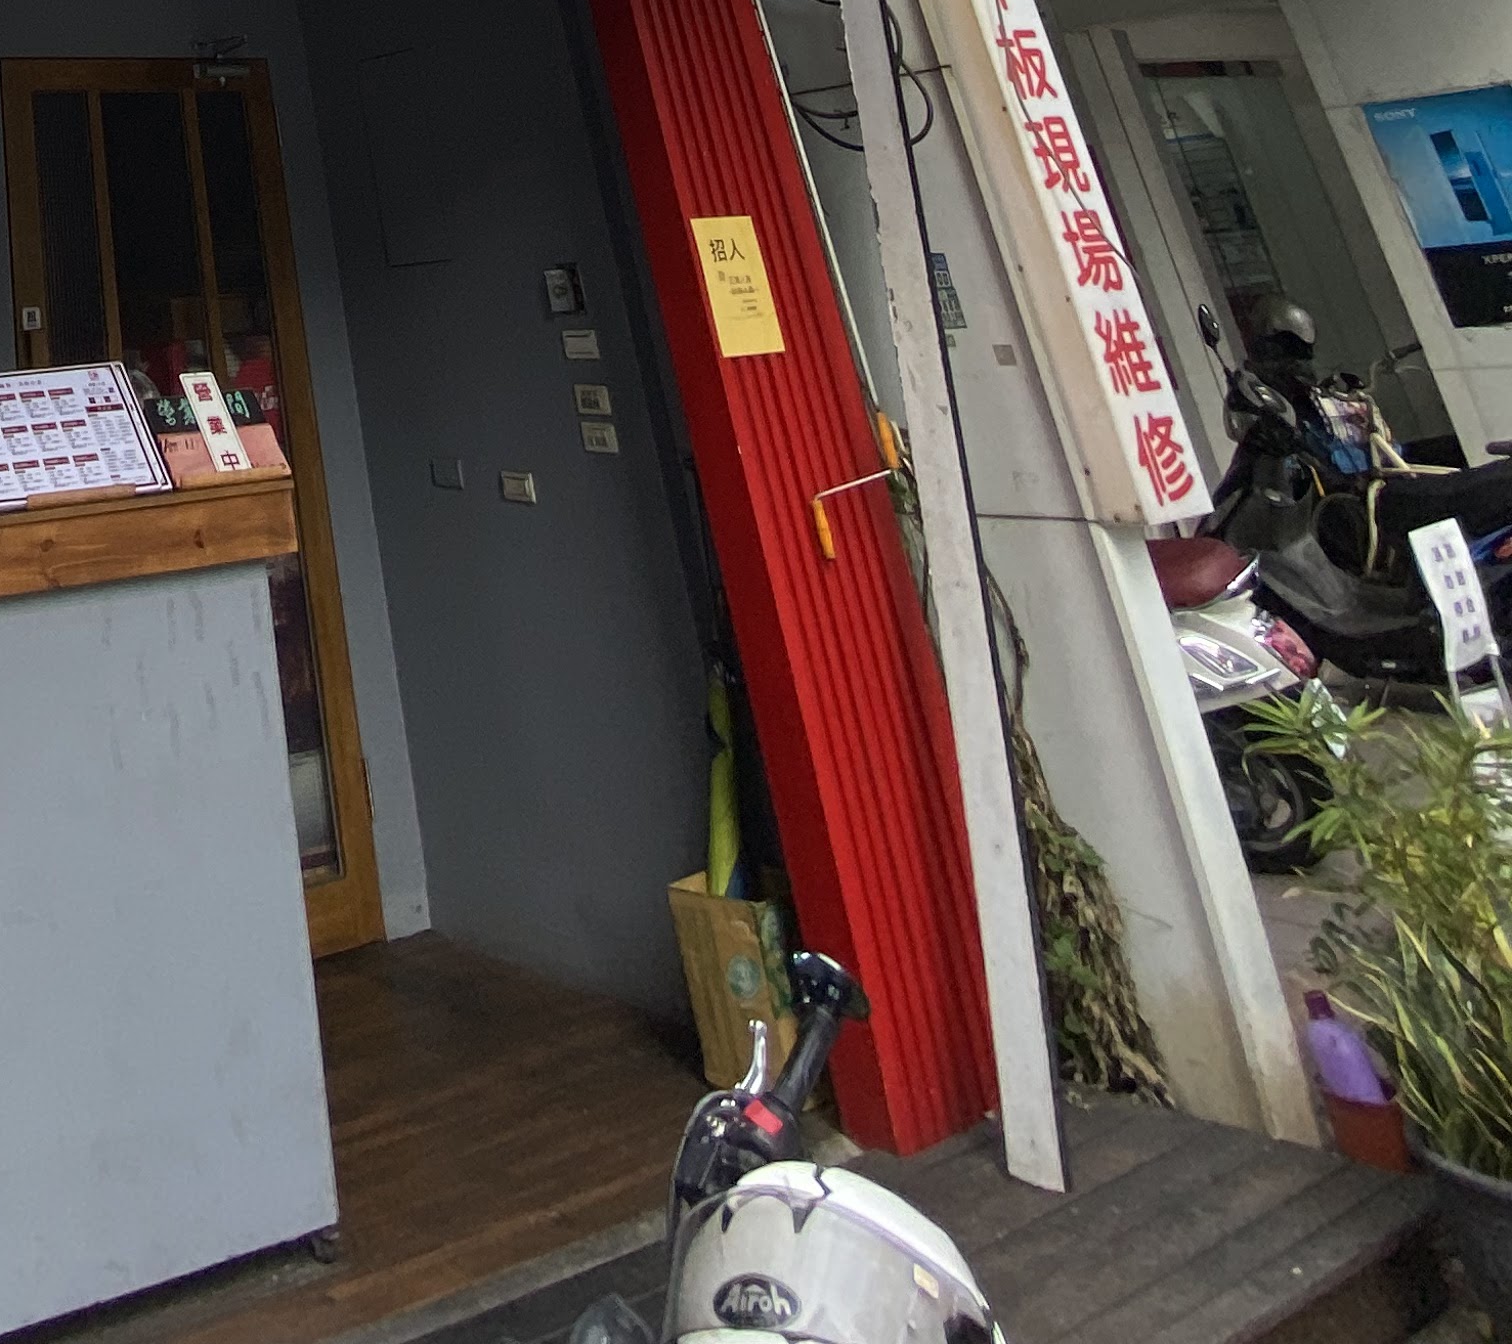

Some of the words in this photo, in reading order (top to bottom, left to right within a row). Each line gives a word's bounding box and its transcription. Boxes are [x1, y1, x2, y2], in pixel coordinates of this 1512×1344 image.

[1373, 108, 1416, 122] SONY
[708, 237, 746, 263] 招人
[719, 1282, 792, 1317] Airoh
